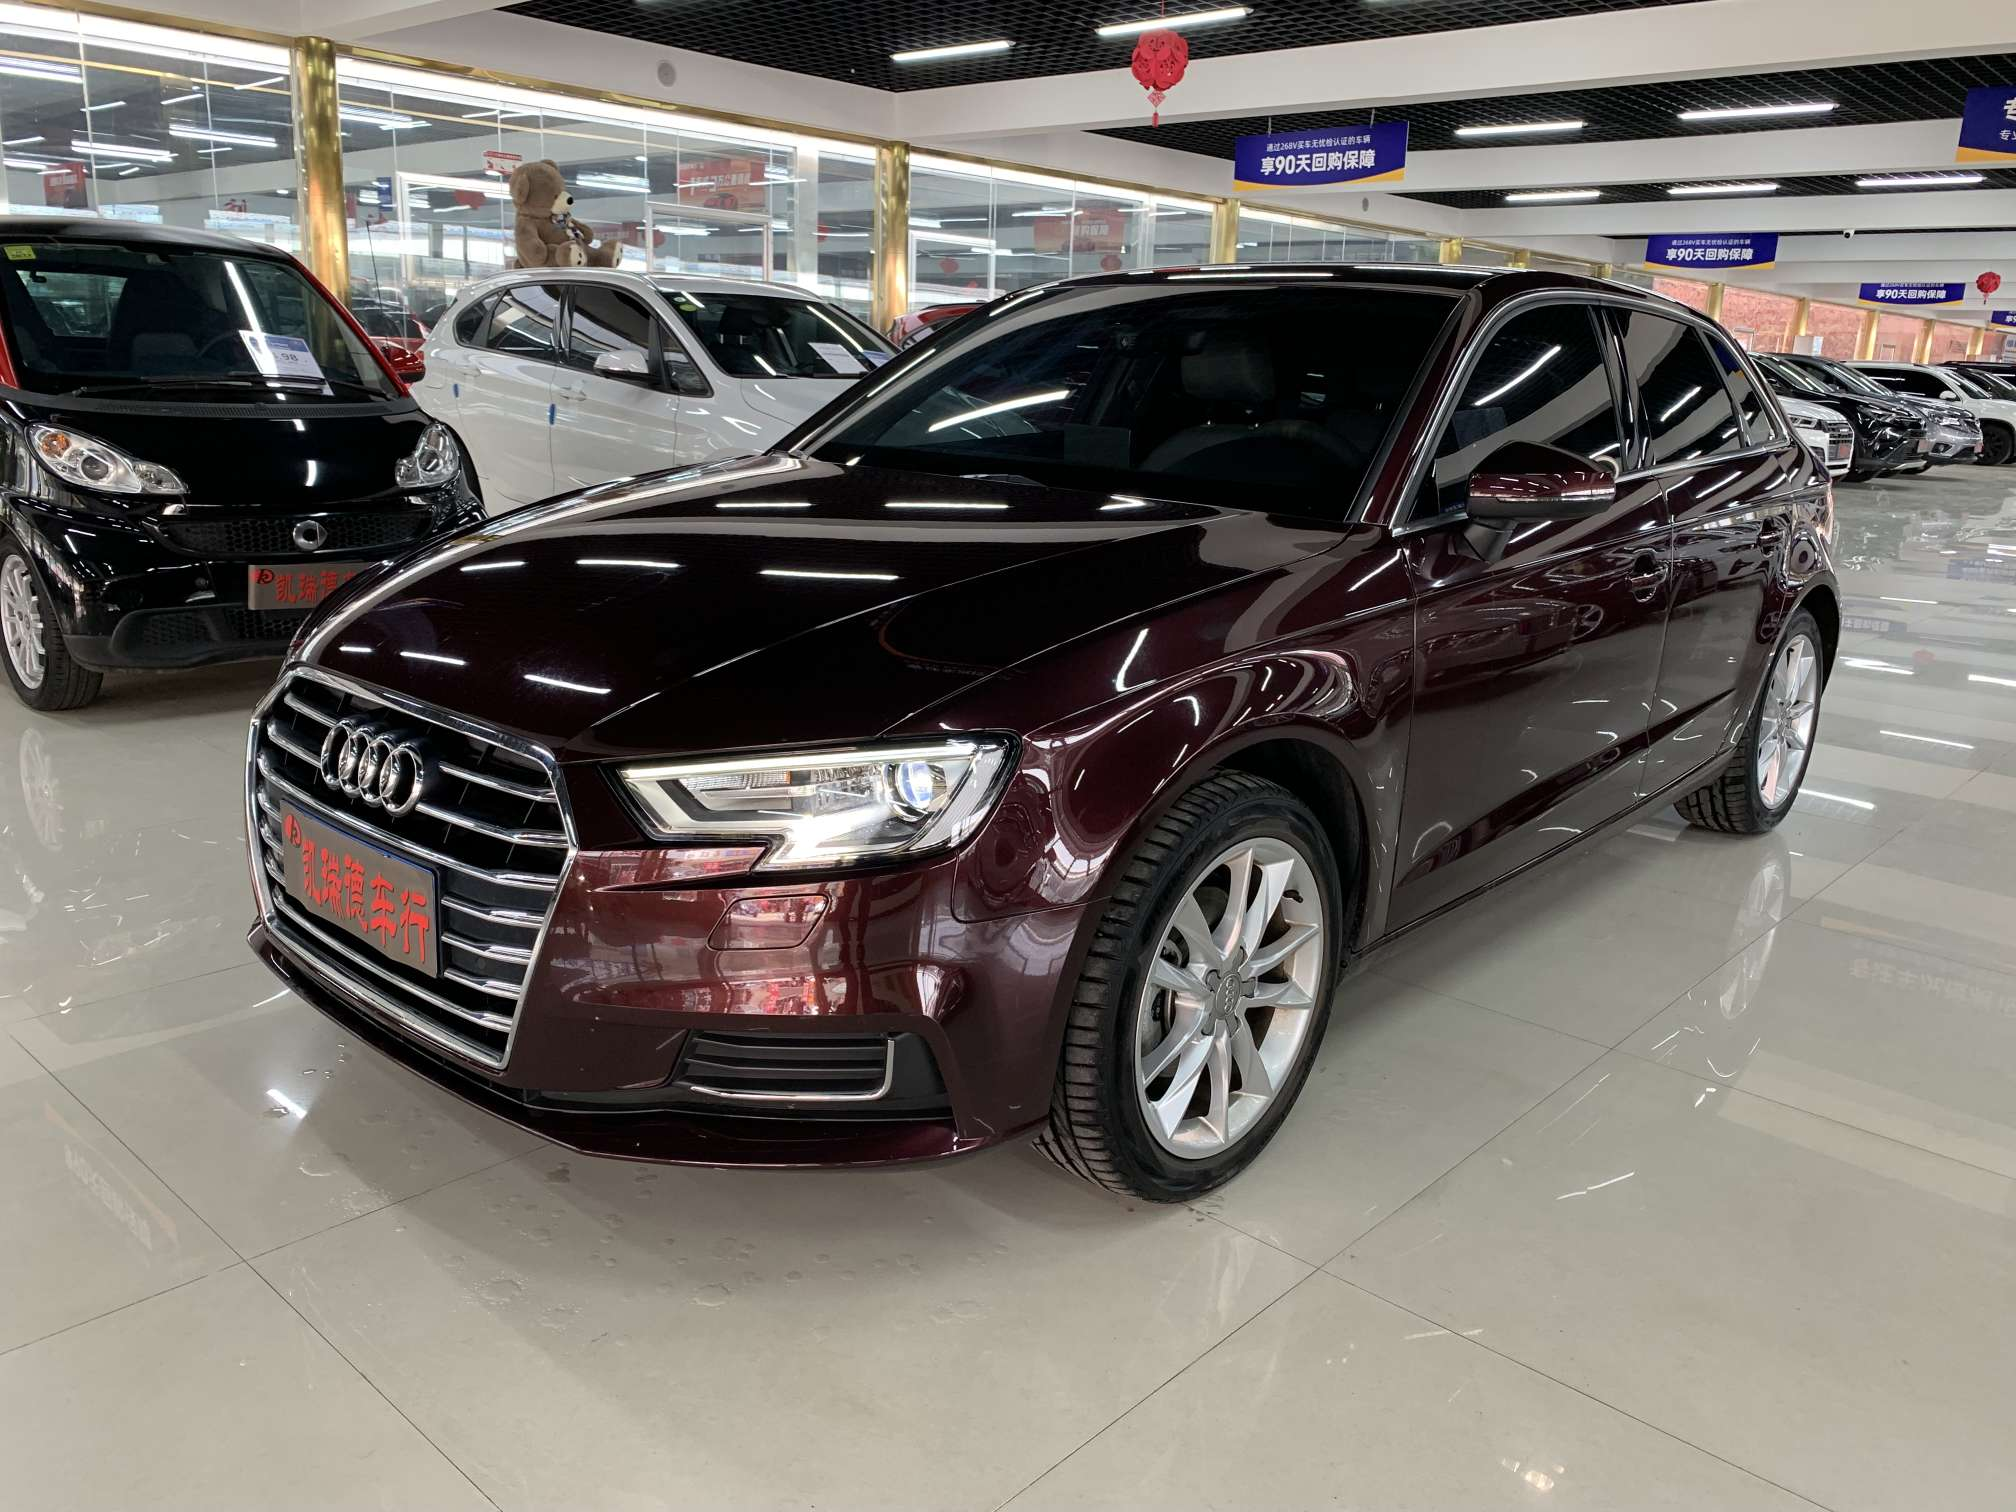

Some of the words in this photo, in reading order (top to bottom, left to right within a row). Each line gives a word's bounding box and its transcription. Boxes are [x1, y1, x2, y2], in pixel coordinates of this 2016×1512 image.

[1260, 149, 1376, 176] 享90天回购保障
[1665, 248, 1754, 261] 享90天回购保障
[303, 839, 429, 964] 凯瑞德车行
